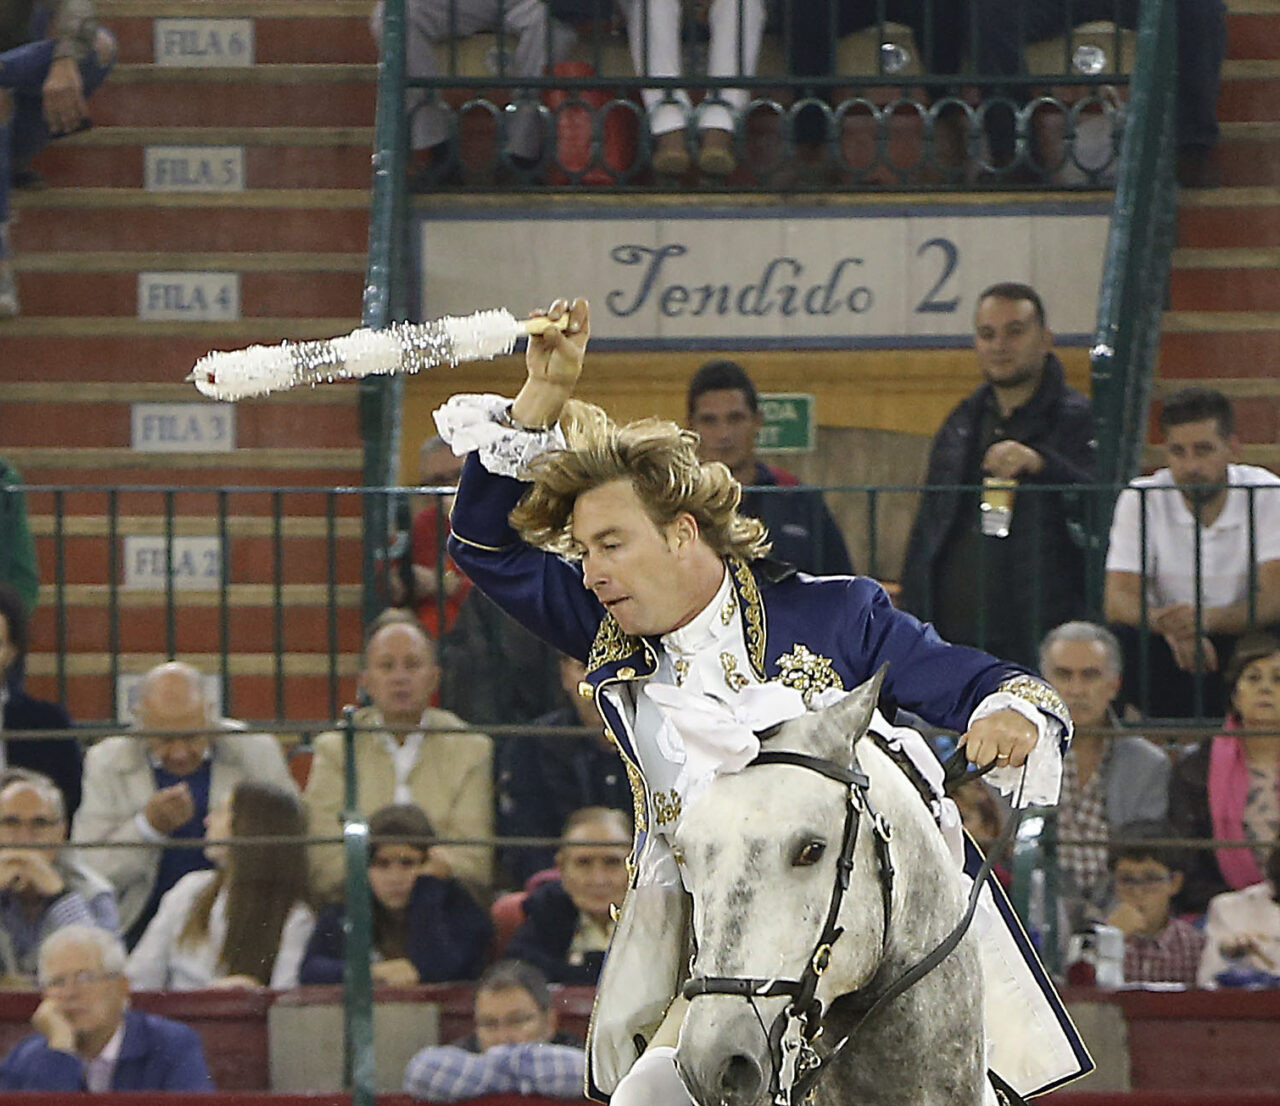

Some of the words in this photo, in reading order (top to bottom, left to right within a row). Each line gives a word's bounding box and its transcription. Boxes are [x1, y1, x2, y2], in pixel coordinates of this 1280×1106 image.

[164, 29, 224, 56] FILA
[228, 31, 243, 56] 6
[156, 158, 215, 185] FILA
[222, 158, 238, 185] 5
[606, 243, 874, 317] Tendido
[915, 237, 962, 314] 2
[148, 283, 208, 311] FILA
[214, 285, 231, 310] 4
[142, 414, 204, 443] FILA
[203, 548, 219, 577] 2
